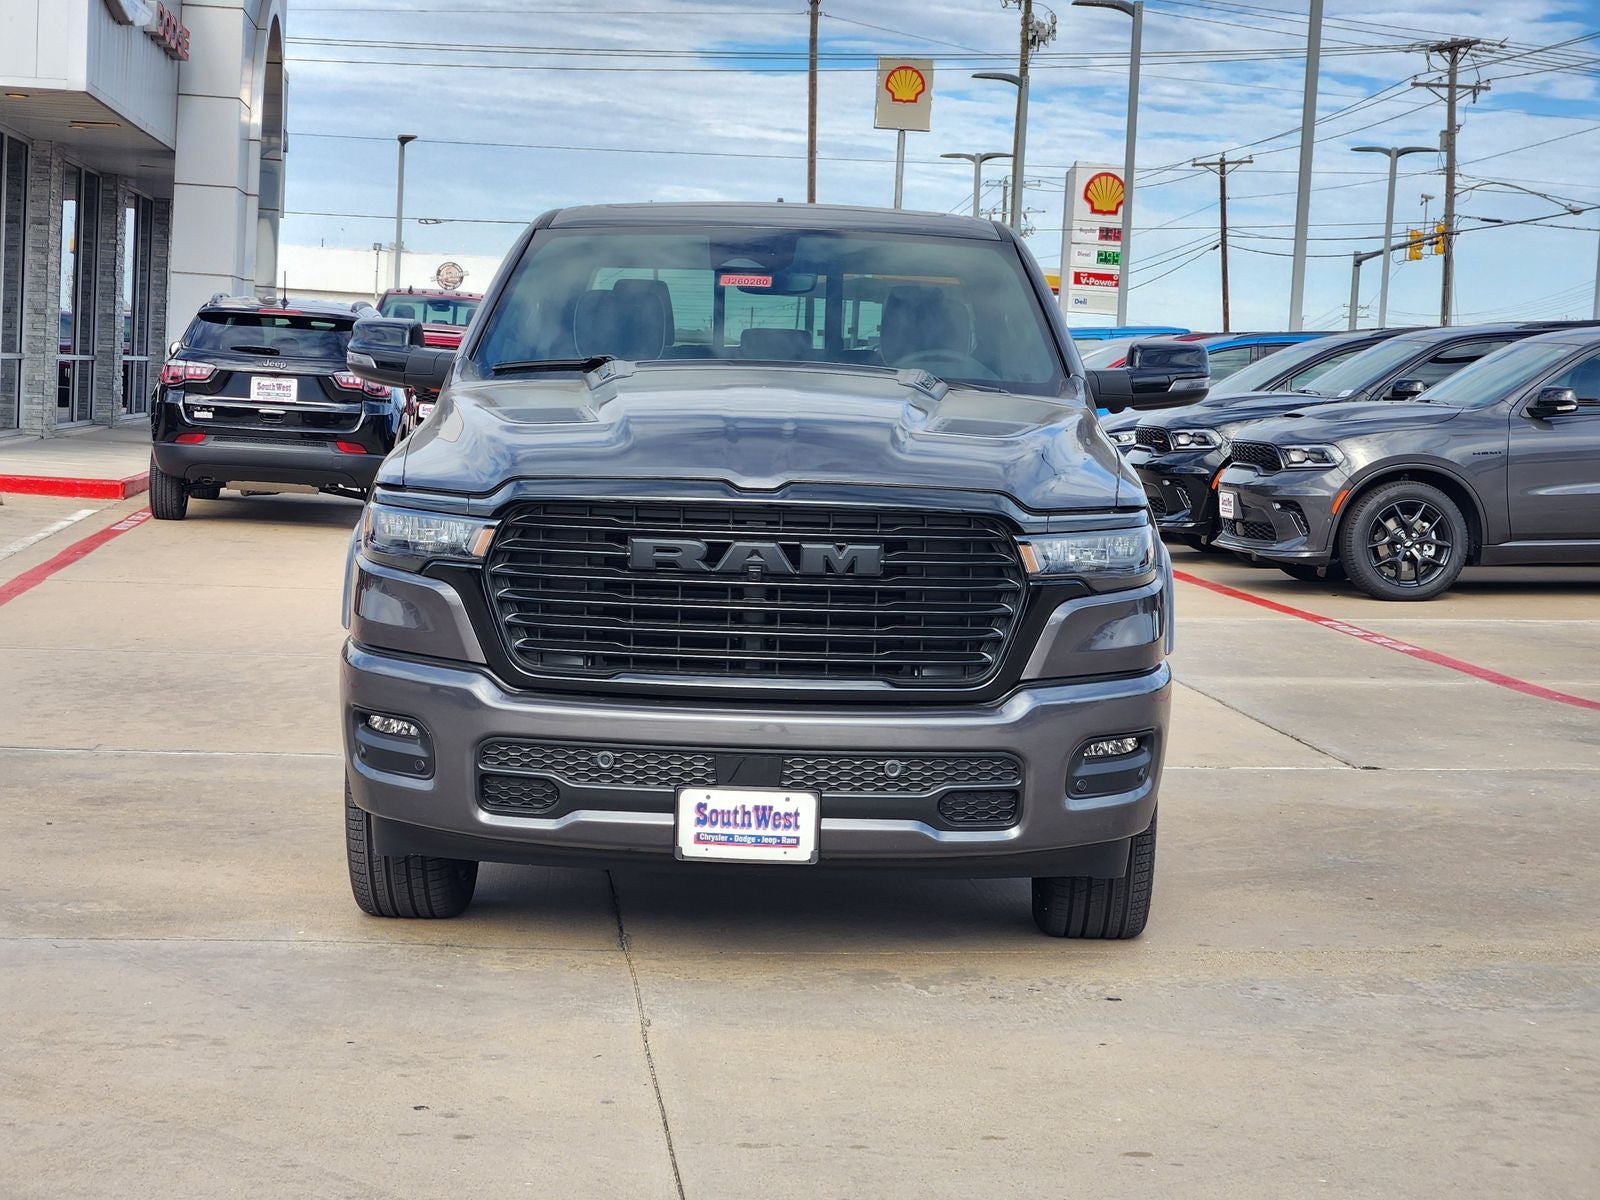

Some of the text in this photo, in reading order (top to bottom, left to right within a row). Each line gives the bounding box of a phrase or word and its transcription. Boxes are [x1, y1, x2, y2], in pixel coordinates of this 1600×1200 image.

[724, 277, 768, 285] J260280
[262, 359, 288, 369] Jeep
[630, 537, 882, 576] RAM
[699, 833, 797, 845] Chrysler Dodge Jeep Ram
